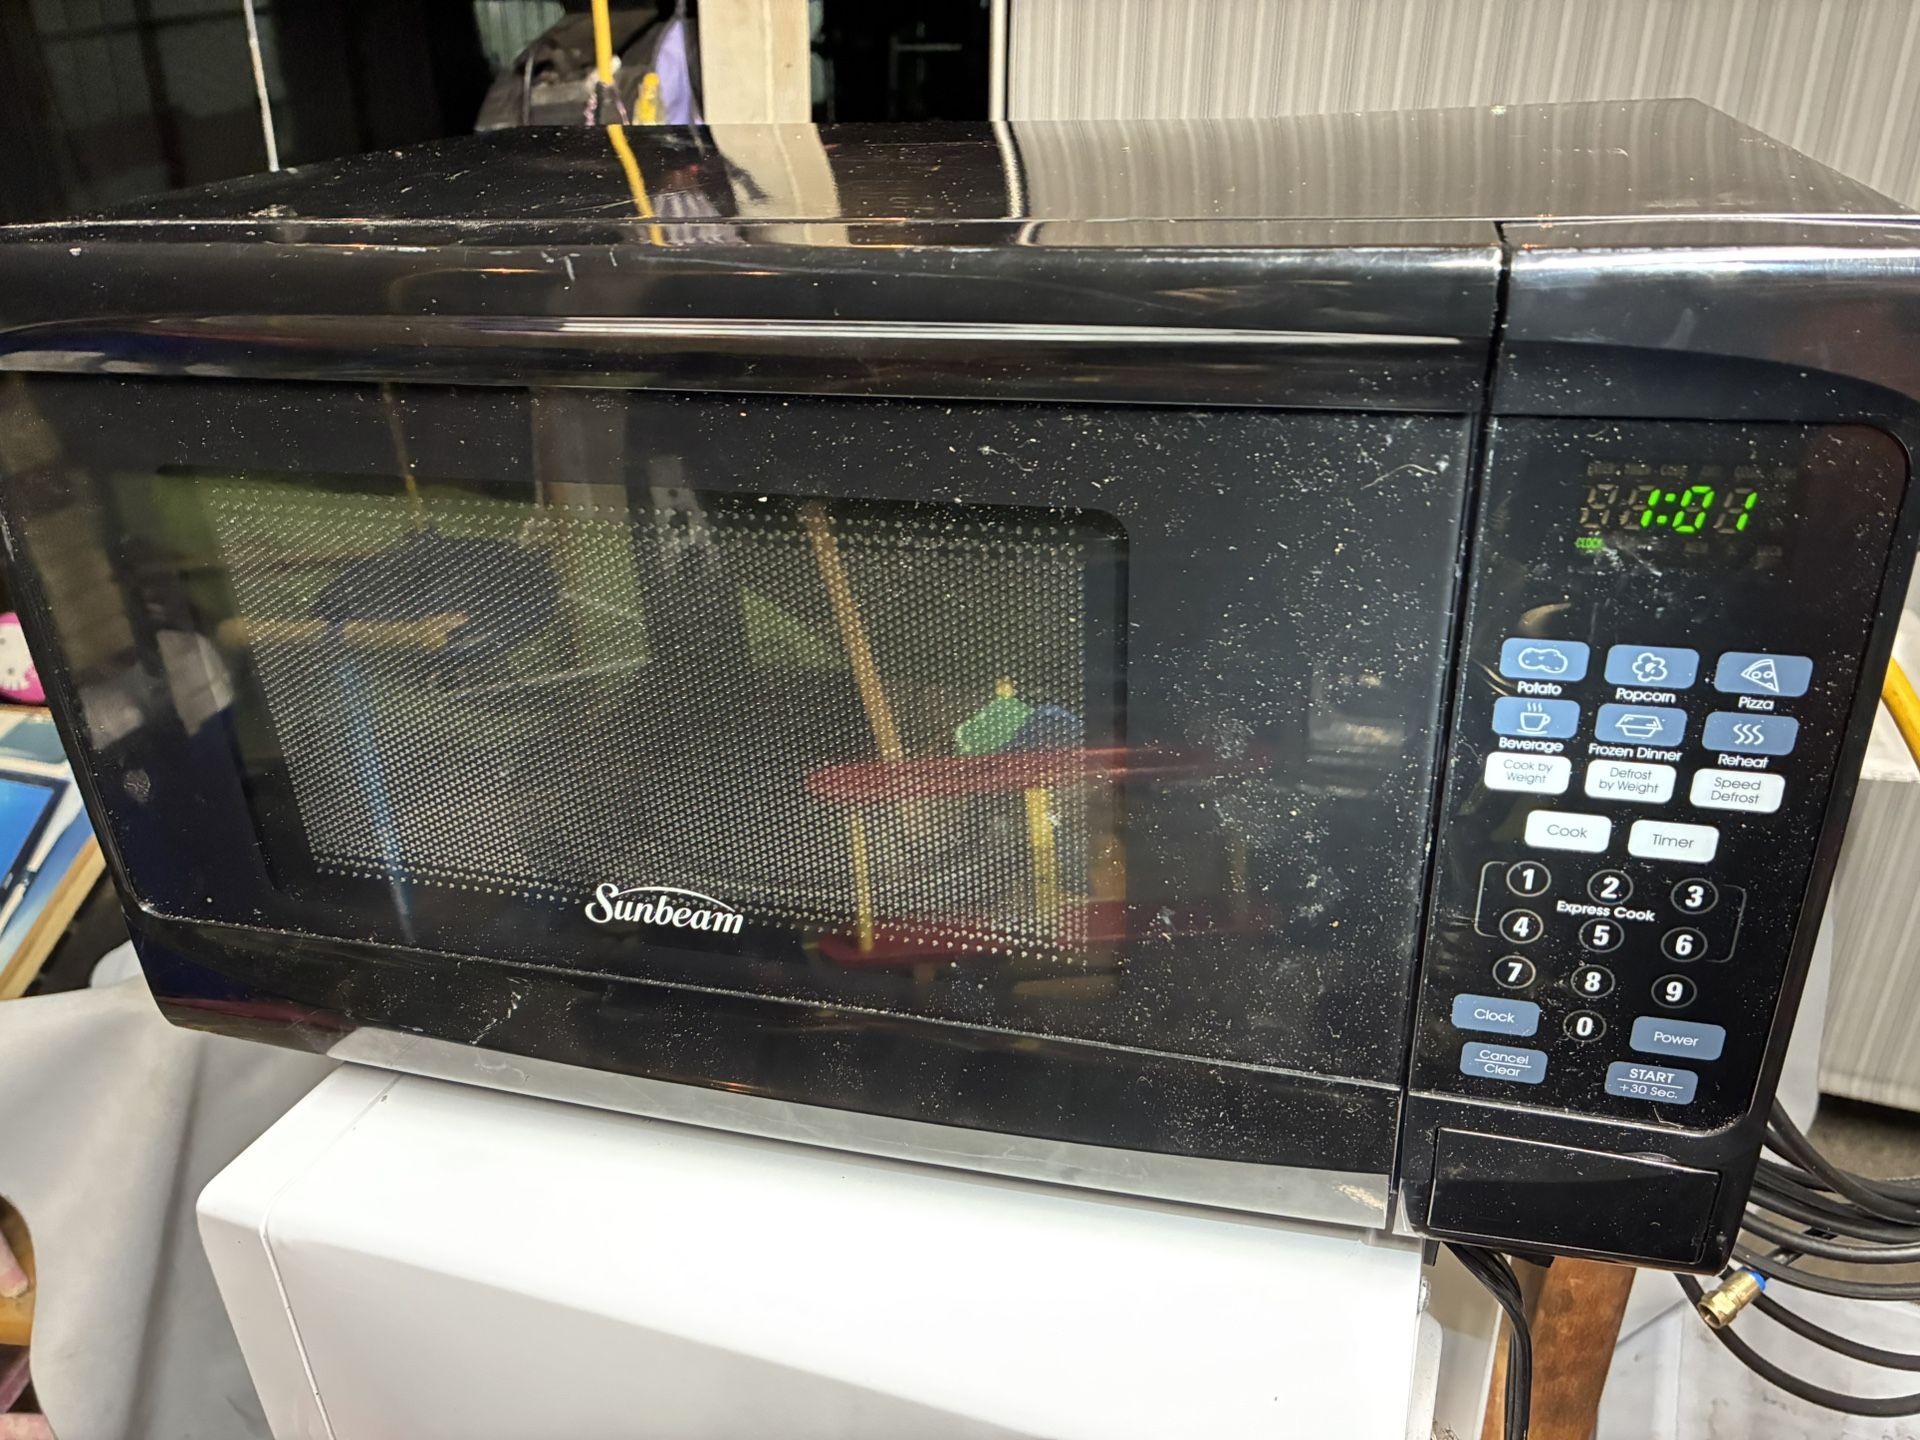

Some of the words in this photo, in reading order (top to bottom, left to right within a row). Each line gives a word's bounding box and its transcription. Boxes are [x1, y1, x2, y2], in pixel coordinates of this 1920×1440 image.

[1640, 485, 1758, 533] 1:01
[1517, 681, 1562, 696] Potato
[1616, 688, 1676, 704] Popcorn
[1738, 696, 1774, 711] Pizza
[1499, 737, 1564, 753] Beverage
[1589, 743, 1633, 758] Frozen
[1637, 747, 1683, 761] Dinner
[1503, 759, 1534, 771] Cook
[1538, 763, 1553, 775] by
[1718, 754, 1769, 769] Reheat
[1507, 771, 1547, 785] Weight
[1610, 767, 1652, 780] Defrost
[1599, 780, 1614, 791] by
[1616, 781, 1659, 795] Weight
[1714, 776, 1761, 793] Speed
[1711, 790, 1760, 805] Defrost
[1547, 824, 1588, 839] Cook
[1652, 834, 1694, 849] Timer
[1522, 868, 1536, 890] 1
[1600, 877, 1620, 899] 2
[1685, 886, 1704, 908] 3
[585, 883, 744, 934] Sunbeam
[1556, 900, 1611, 917] Express
[1614, 906, 1655, 922] Cook
[1512, 916, 1529, 937] 4
[1593, 925, 1610, 946] 5
[1675, 934, 1693, 955] 6
[1507, 963, 1523, 983] 7
[1584, 972, 1601, 992] 8
[1665, 981, 1684, 1001] 9
[1474, 1008, 1515, 1024] Clock
[1576, 1017, 1593, 1036] 0
[1654, 1031, 1699, 1048] Power
[1479, 1049, 1530, 1066] Cancel
[1484, 1063, 1521, 1078] Clear
[1629, 1068, 1675, 1084] START
[1619, 1083, 1648, 1096] +30
[1651, 1085, 1678, 1100] Sec.
